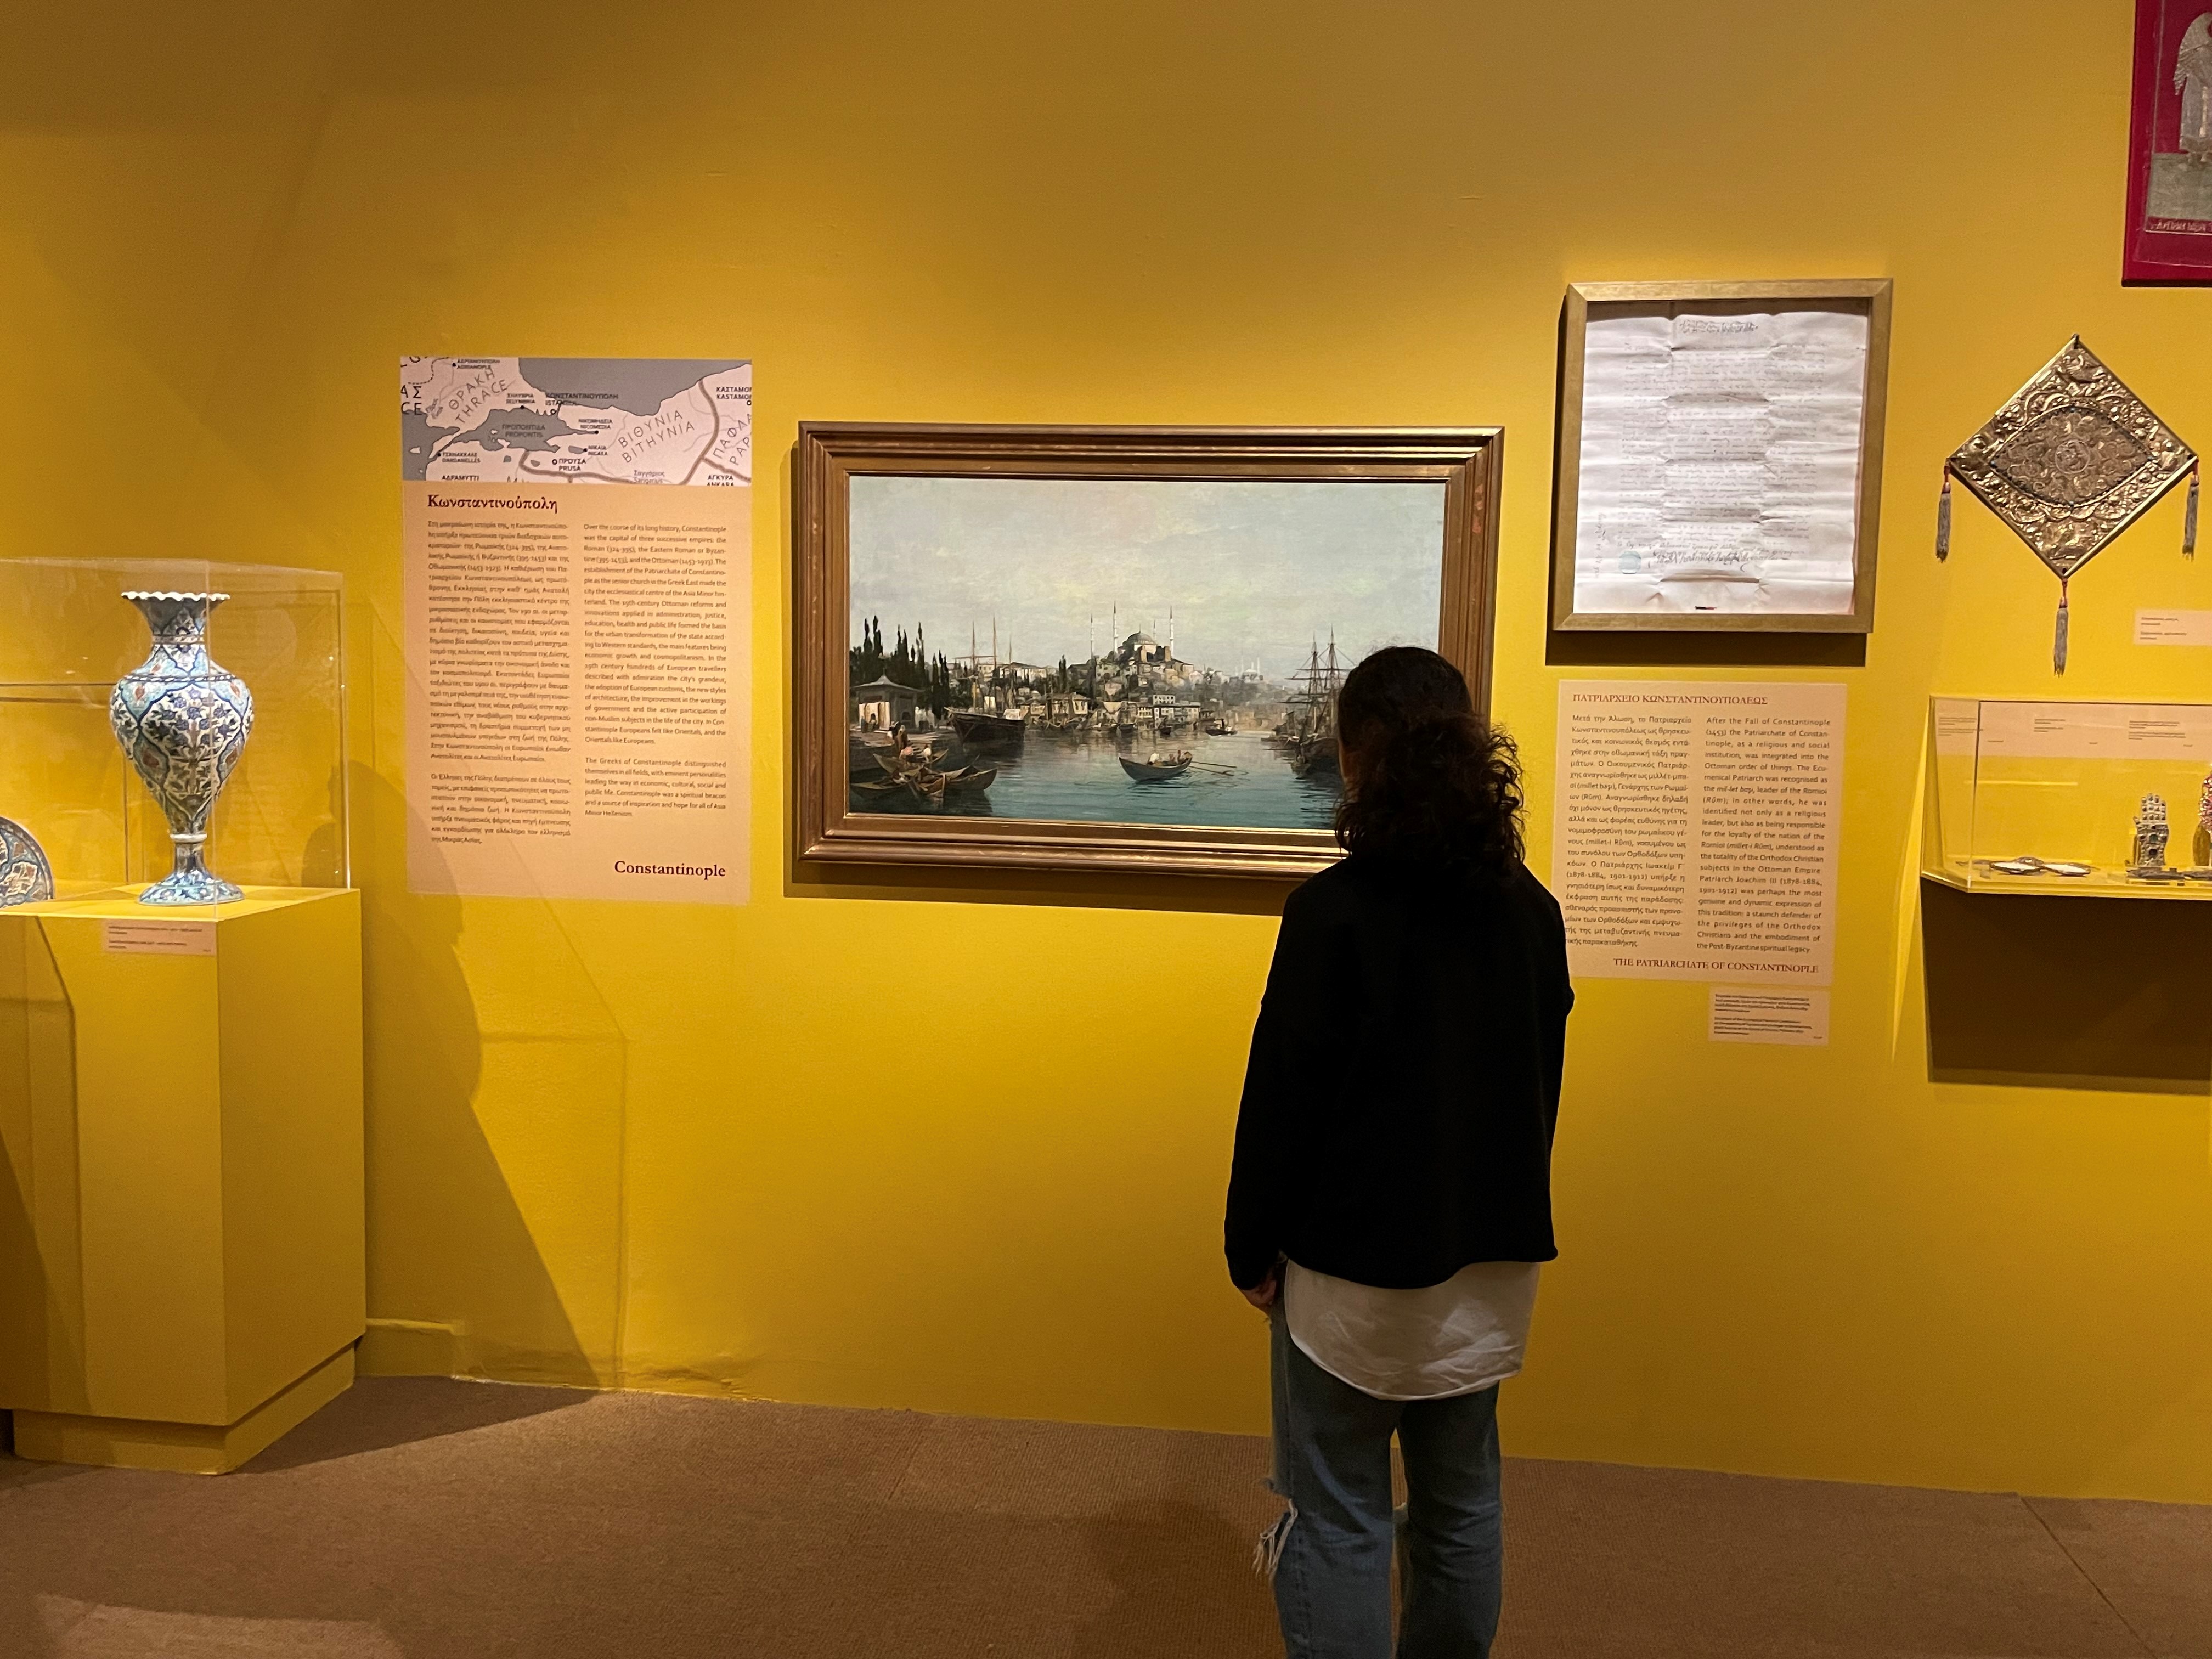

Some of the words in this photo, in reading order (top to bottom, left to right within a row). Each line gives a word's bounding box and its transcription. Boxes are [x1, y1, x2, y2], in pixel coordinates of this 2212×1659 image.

[449, 367, 495, 410] ΘΡΑΚΗ
[455, 379, 508, 423] THRACE
[618, 410, 683, 448] ΒΙΘΥΝΙΑ
[622, 421, 695, 463] BITHYNIA
[428, 494, 558, 514] Κωνσταντινούπολη
[1573, 694, 1640, 703] ΠΑΤΡΙΑΡΧΕΙΟ
[1643, 695, 1768, 704] ΚΩΝΣΤΑΝΤΙΝΟΥΠΟΛΕΩΣ
[1773, 718, 1830, 727] Constantinople
[1756, 741, 1787, 749] religious
[1761, 752, 1797, 761] integrated
[1756, 809, 1771, 817] only
[1794, 810, 1826, 819] religious
[1765, 820, 1785, 829] being
[1786, 821, 1825, 830] responsible
[1728, 831, 1751, 839] loyalty
[614, 860, 726, 880] Constantinople
[1757, 888, 1785, 897] perhaps
[1714, 920, 1752, 929] privileges
[1765, 933, 1809, 941] embodiment
[1613, 958, 1634, 966] THE
[1636, 958, 1709, 969] PATRIARCHATE
[1711, 961, 1725, 969] OF
[1728, 962, 1819, 973] CONSTANTINOPLE
